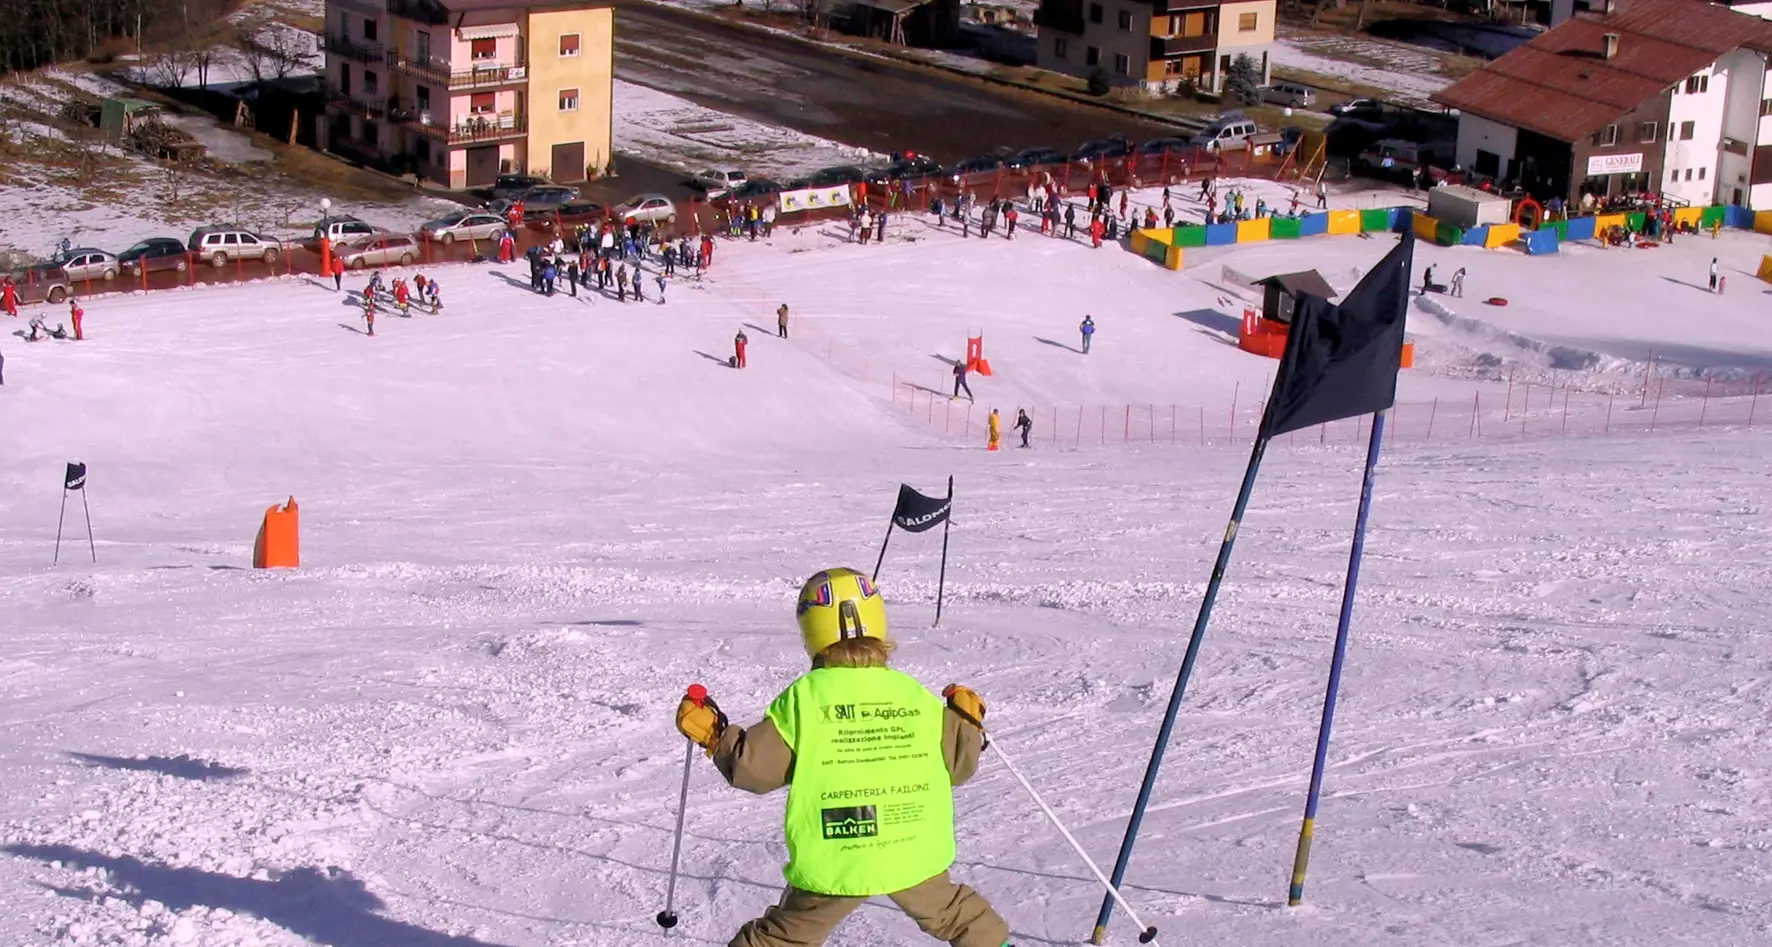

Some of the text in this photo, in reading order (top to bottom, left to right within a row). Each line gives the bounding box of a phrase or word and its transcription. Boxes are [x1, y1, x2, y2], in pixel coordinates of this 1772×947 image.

[874, 707, 921, 720] AgipGas
[820, 783, 930, 800] CARPENTERIA FAILONI
[826, 824, 876, 836] BALKEN
